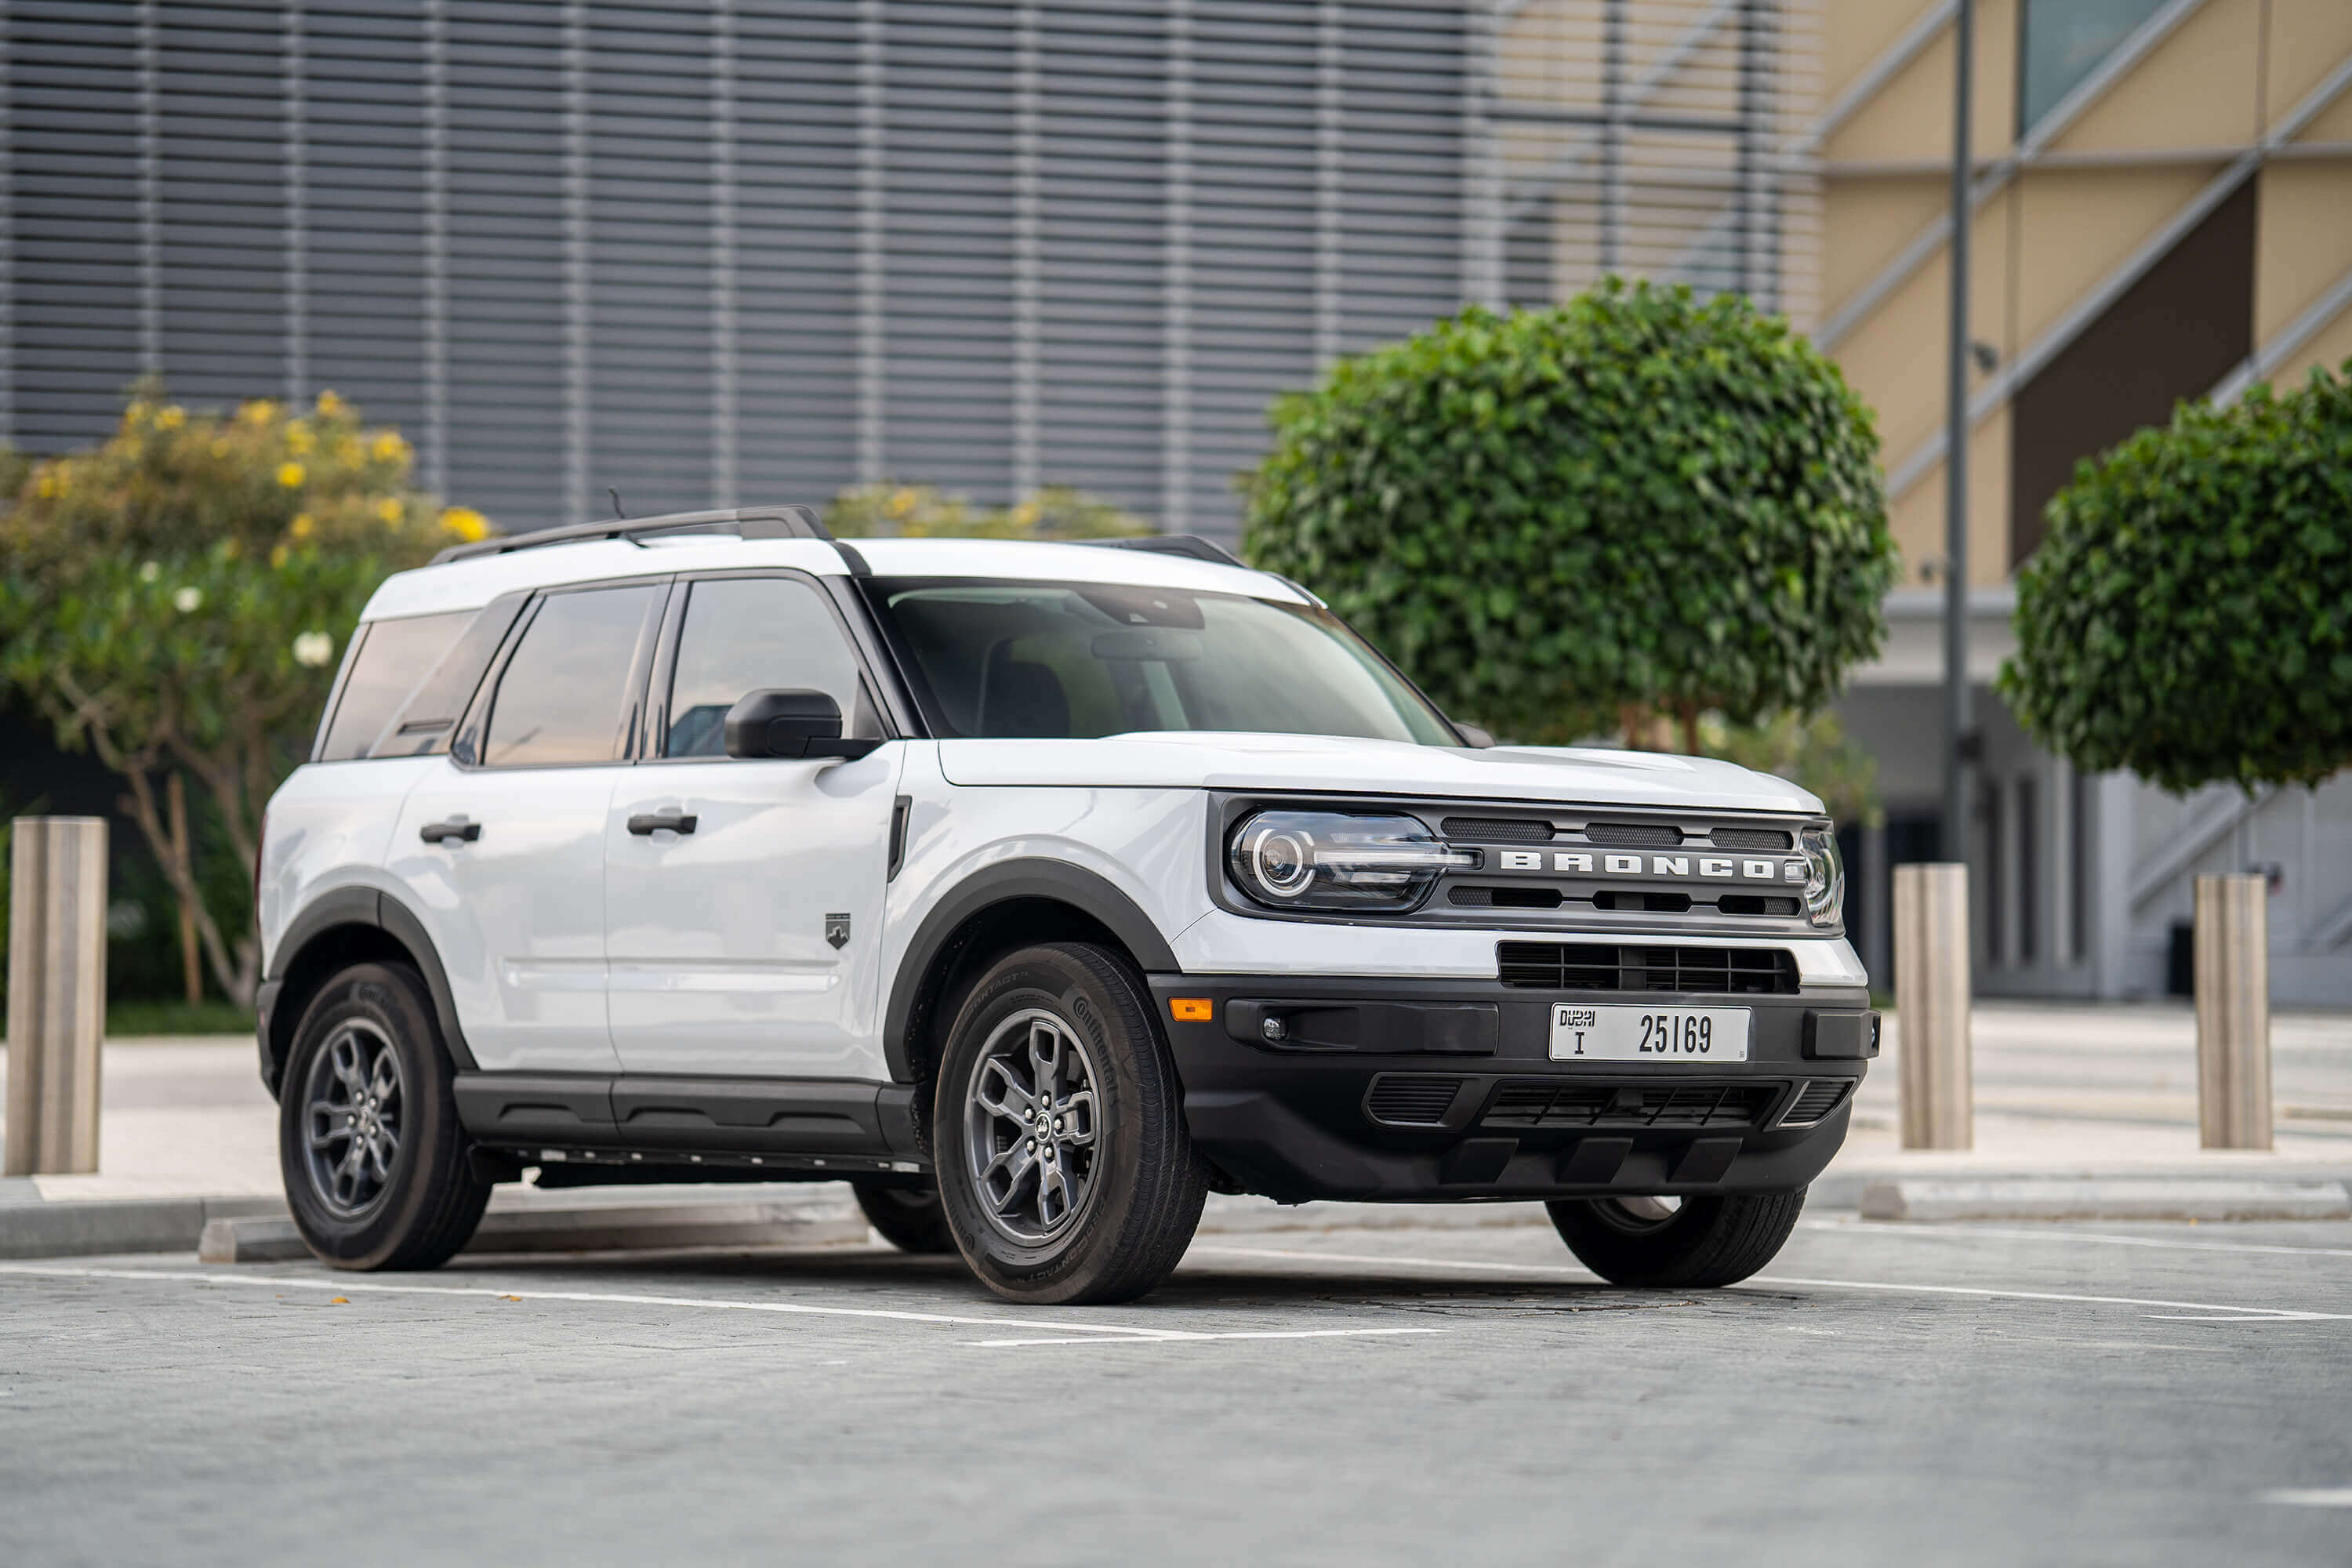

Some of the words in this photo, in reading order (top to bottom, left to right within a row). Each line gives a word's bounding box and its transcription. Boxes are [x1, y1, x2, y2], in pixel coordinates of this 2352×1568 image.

[1500, 851, 1775, 879] BRONCO
[1073, 996, 1118, 1093] Continental
[1574, 1032, 1584, 1054] I
[1639, 1014, 1711, 1053] 25169
